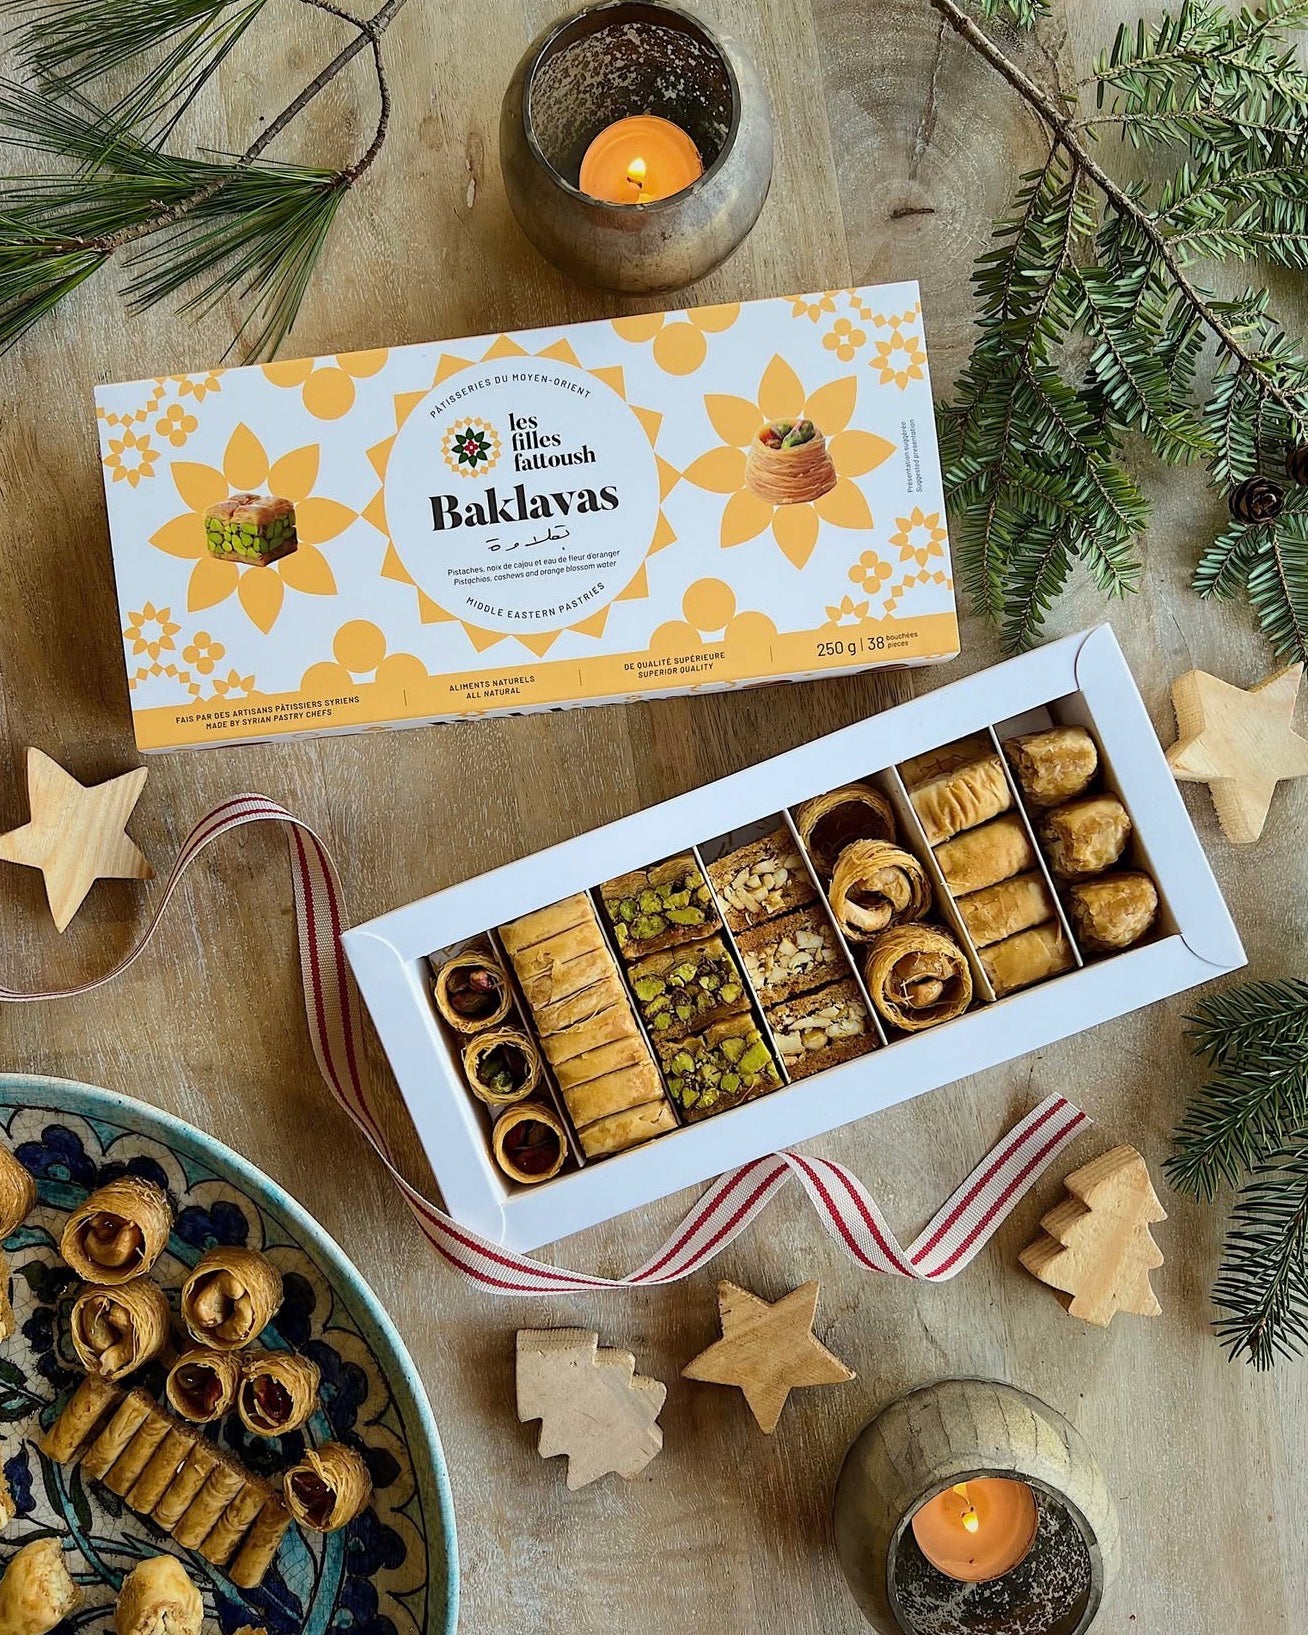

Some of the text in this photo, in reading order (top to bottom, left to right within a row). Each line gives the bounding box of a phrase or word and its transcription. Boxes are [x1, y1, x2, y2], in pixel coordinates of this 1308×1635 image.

[430, 374, 591, 418] PÂTISSERIES DU MOYEN-ORIENT
[508, 412, 538, 432] les
[512, 430, 561, 452] filles
[514, 444, 596, 472] fattoush
[428, 484, 619, 532] Baklavas
[494, 572, 524, 581] cashews
[526, 569, 539, 577] and
[540, 567, 564, 576] orange
[566, 563, 595, 572] blossom
[596, 560, 616, 569] water
[514, 560, 534, 569] cajou
[466, 582, 605, 619] MIDDLE EASTERN PASTRIES
[816, 636, 885, 656] 250 g 38
[886, 632, 918, 640] bouchées
[624, 652, 725, 670] DE QUALITÉ SUPÉRIEURE
[638, 662, 714, 678] SUPERIOR QUALITY
[449, 676, 536, 692] ALIMENTS NATURELS
[484, 687, 520, 697] NATURAL
[176, 696, 360, 724] FAIS PAR DES ARTISANS PÂTISSIERS SYRIENS
[206, 708, 332, 730] MADE BY SYRIAN PASTRY CHEFS
